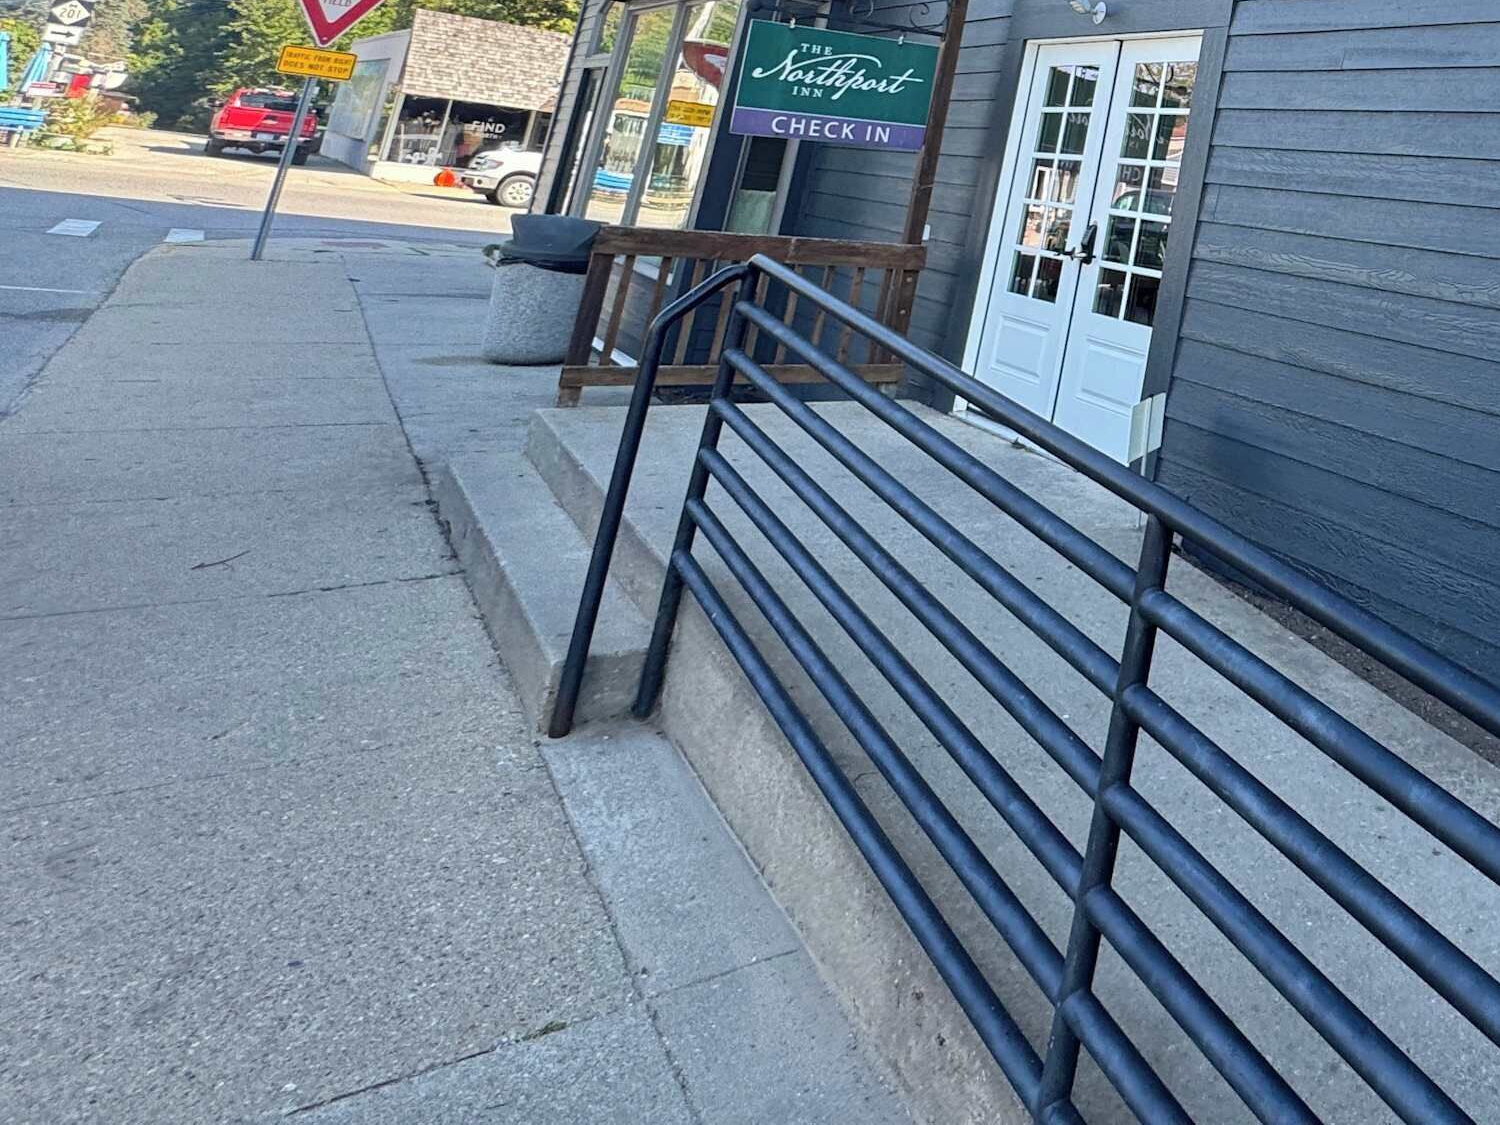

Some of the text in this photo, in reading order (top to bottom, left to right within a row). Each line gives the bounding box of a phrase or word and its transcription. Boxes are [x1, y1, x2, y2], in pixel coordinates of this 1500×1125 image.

[59, 7, 81, 19] 201
[800, 42, 834, 56] THE
[751, 48, 924, 101] Northport
[791, 85, 824, 99] INN
[472, 120, 506, 133] FIND
[771, 115, 891, 143] CHECK IN
